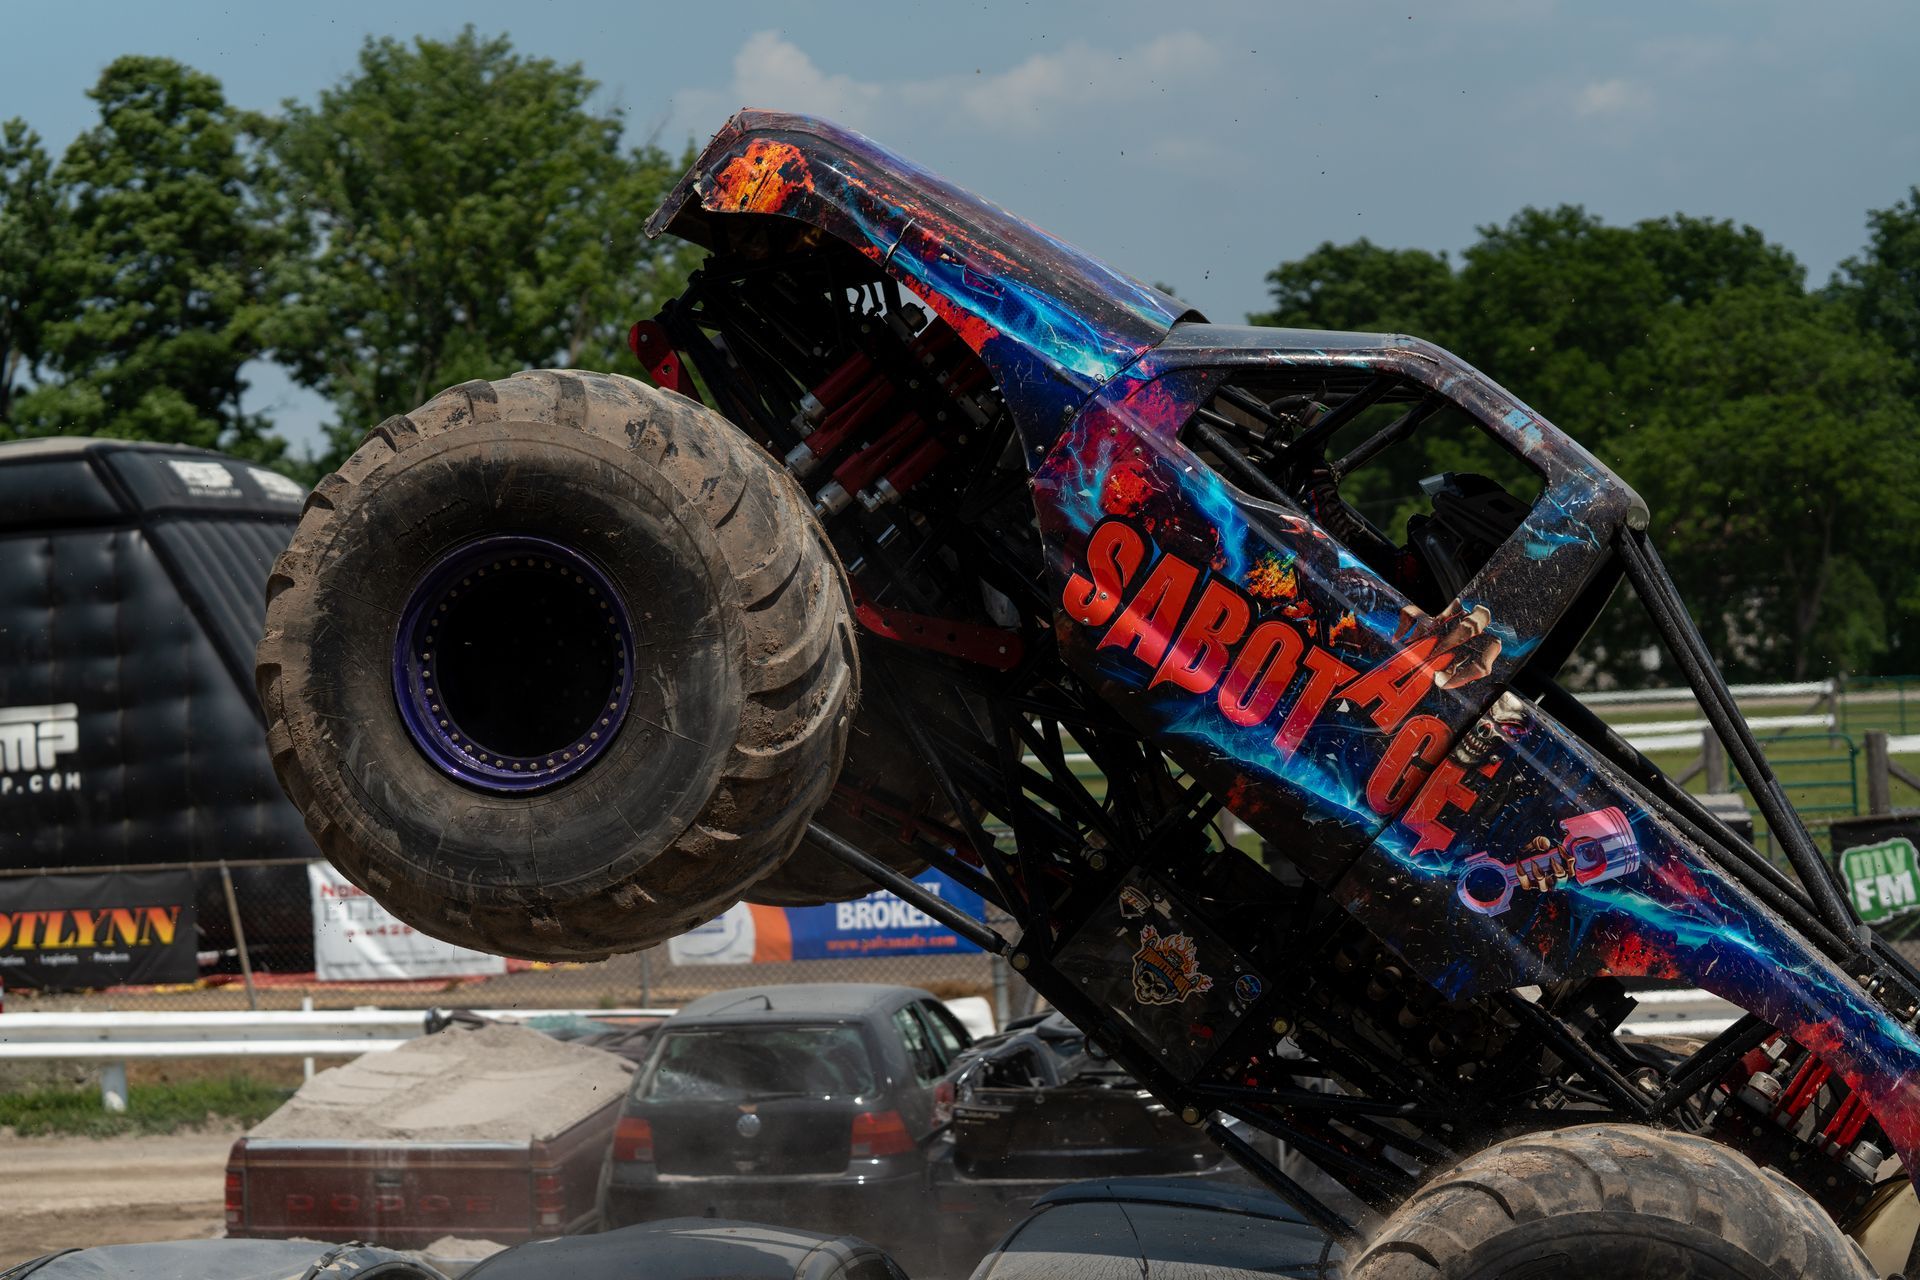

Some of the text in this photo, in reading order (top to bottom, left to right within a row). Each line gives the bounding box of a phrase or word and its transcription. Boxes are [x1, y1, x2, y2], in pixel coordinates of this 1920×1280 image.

[1063, 521, 1500, 856] SABOTAGE
[1854, 870, 1917, 912] FM
[287, 1193, 497, 1214] DODGE
